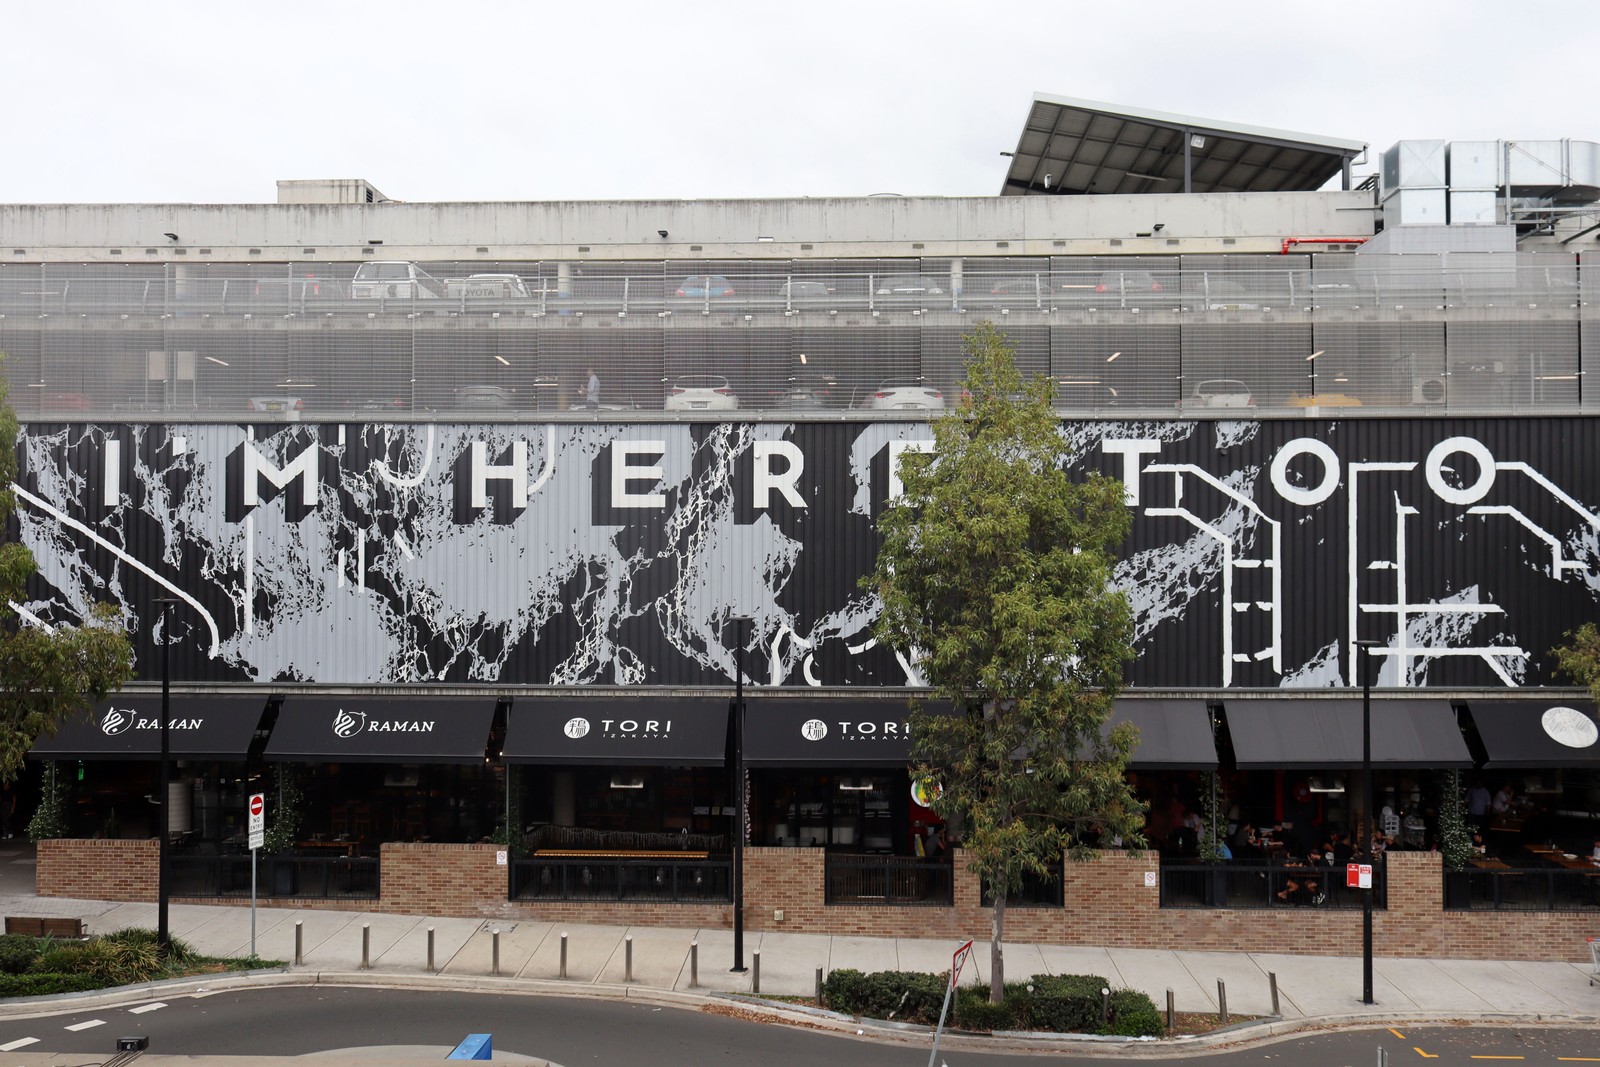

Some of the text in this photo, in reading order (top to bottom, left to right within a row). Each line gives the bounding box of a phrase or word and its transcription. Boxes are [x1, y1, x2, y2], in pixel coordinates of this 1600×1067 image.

[104, 437, 319, 507] I'M
[1102, 436, 1496, 507] TOO
[367, 721, 435, 732] RAMAN
[601, 719, 672, 733] TORI
[838, 721, 910, 734] TORI
[250, 823, 263, 831] ENTRY
